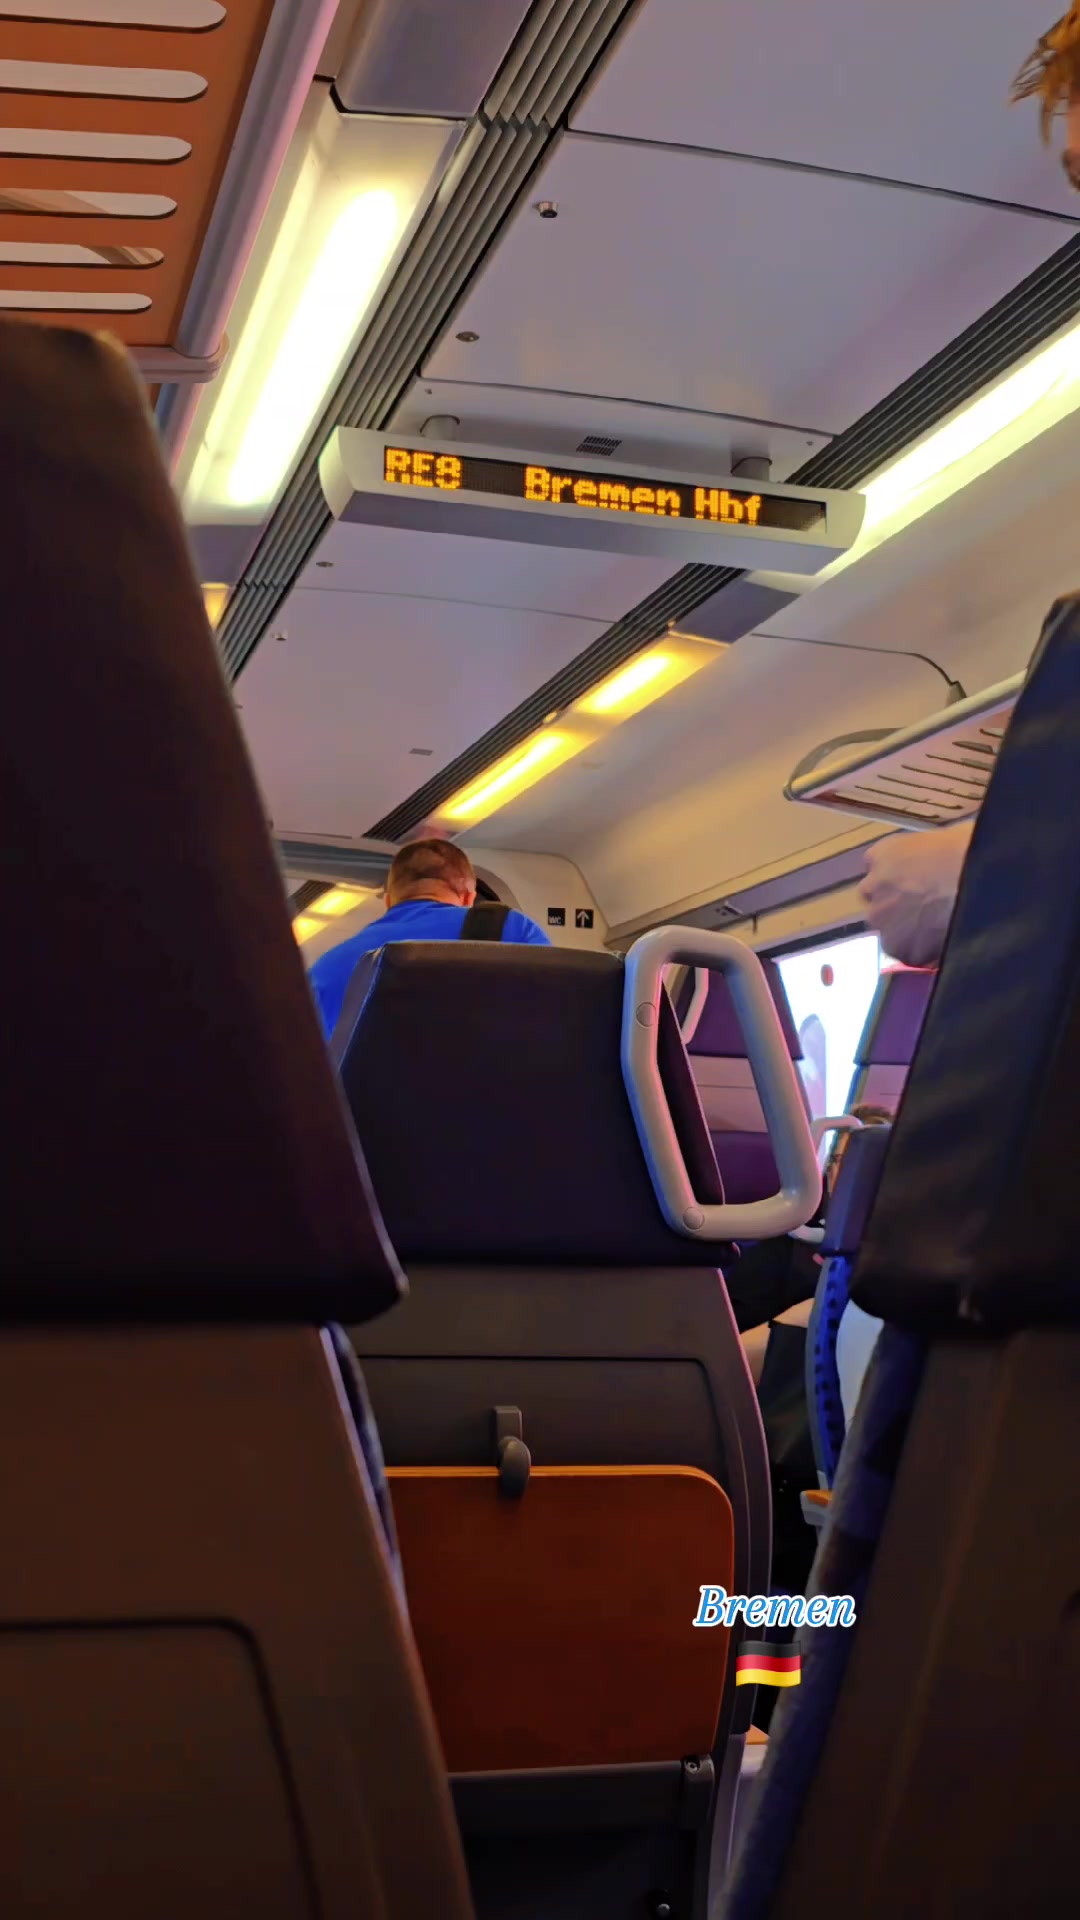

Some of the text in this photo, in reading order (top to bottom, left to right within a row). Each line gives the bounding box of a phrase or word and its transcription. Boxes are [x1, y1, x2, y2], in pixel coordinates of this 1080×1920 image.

[385, 448, 762, 526] RE8 Bremen Hbf
[548, 916, 562, 925] WC
